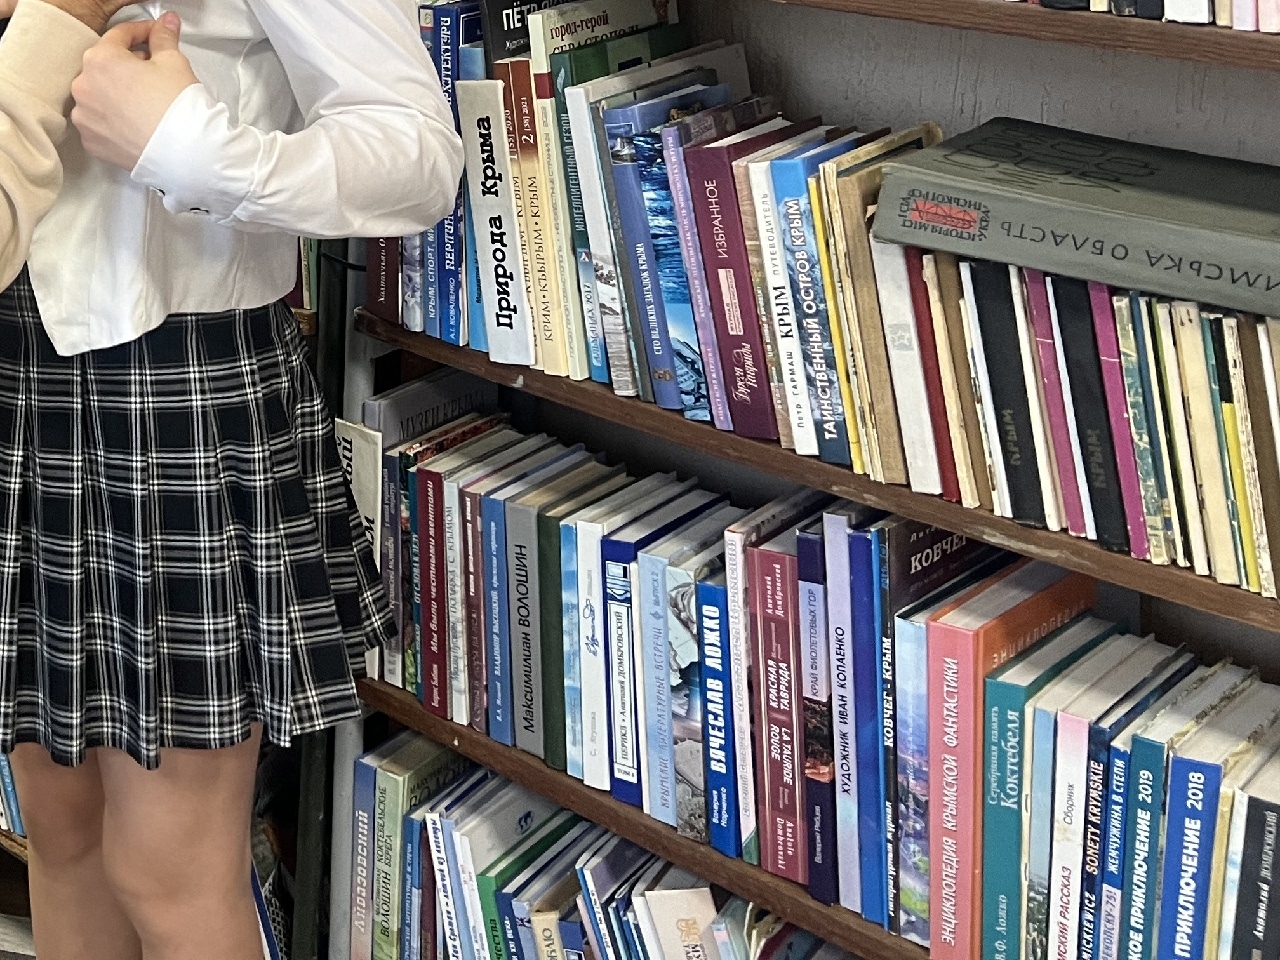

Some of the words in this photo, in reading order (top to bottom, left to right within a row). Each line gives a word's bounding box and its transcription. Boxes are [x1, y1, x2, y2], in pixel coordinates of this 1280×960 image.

[549, 10, 610, 40] город-герой
[559, 112, 575, 139] СЕЗОН
[475, 115, 500, 199] Крыма
[565, 142, 586, 231] ИНТЕЛЛИГЕНТНЫЙ
[703, 178, 729, 260] ИЗБРАННОЕ
[759, 191, 782, 277] ПУТЕВОДИТЕЛЬ
[784, 198, 807, 247] КРЫМ
[998, 219, 1130, 262] ОБЛАСТЬ
[426, 244, 437, 283] СПОРТ,
[489, 214, 517, 330] Природа
[792, 248, 819, 315] ОСТРОВ
[426, 285, 437, 319] КРЫМ,
[772, 283, 796, 341] КРЫМ
[784, 349, 801, 397] ГАРМАШ
[803, 316, 839, 441] ТАИНСТВЕННЫЙ
[793, 403, 806, 429] Петр
[425, 480, 436, 537] ментами
[427, 537, 439, 600] честными
[513, 544, 531, 628] ВОЛОШИН
[429, 602, 439, 631] были
[429, 631, 439, 654] Мы
[700, 604, 723, 670] ЛОЖКО
[520, 631, 536, 733] Максимилиан
[766, 659, 780, 709] КРАСНАЯ
[834, 626, 847, 689] КОПАЕНКО
[881, 636, 893, 681] КРЫМ
[776, 662, 791, 711] ТАВРИДА
[836, 694, 849, 725] ИВАН
[940, 656, 959, 748] ФАНТАСТИКИ
[705, 677, 728, 775] ВЯЧЕСЛАВ
[769, 723, 781, 760] ROUGE
[882, 690, 894, 747] КОВЧЕГ
[780, 742, 793, 786] TAURIDE
[837, 729, 853, 796] ХУДОЖНИК
[999, 709, 1021, 810] Коктебеля
[1112, 758, 1127, 793] СТЕПИ
[1137, 768, 1153, 804] 2019
[939, 753, 959, 831] КРЫМСКОЙ
[1062, 782, 1076, 826] Сборник
[1086, 759, 1105, 824] KRYMSKIE
[1112, 793, 1124, 803] В
[1186, 771, 1205, 811] 2018
[375, 785, 388, 864] КОКТЕБЕЛЬСКИЕ
[382, 833, 394, 868] БЕРЕГА
[1086, 824, 1102, 876] SONETY
[1106, 804, 1124, 875] ЖЕМЧУЖИНА
[352, 809, 370, 933] Айвазовский
[940, 836, 958, 947] ЭНЦИКЛОПЕДИЯ
[1058, 866, 1073, 921] РАССКАЗ
[1128, 809, 1152, 930] ПРИКЛЮЧЕНИЕ
[1174, 817, 1201, 958] ПРИКЛЮЧЕНИЕ
[379, 870, 392, 938] ВОЛОШИН
[995, 894, 1008, 935] Ложко
